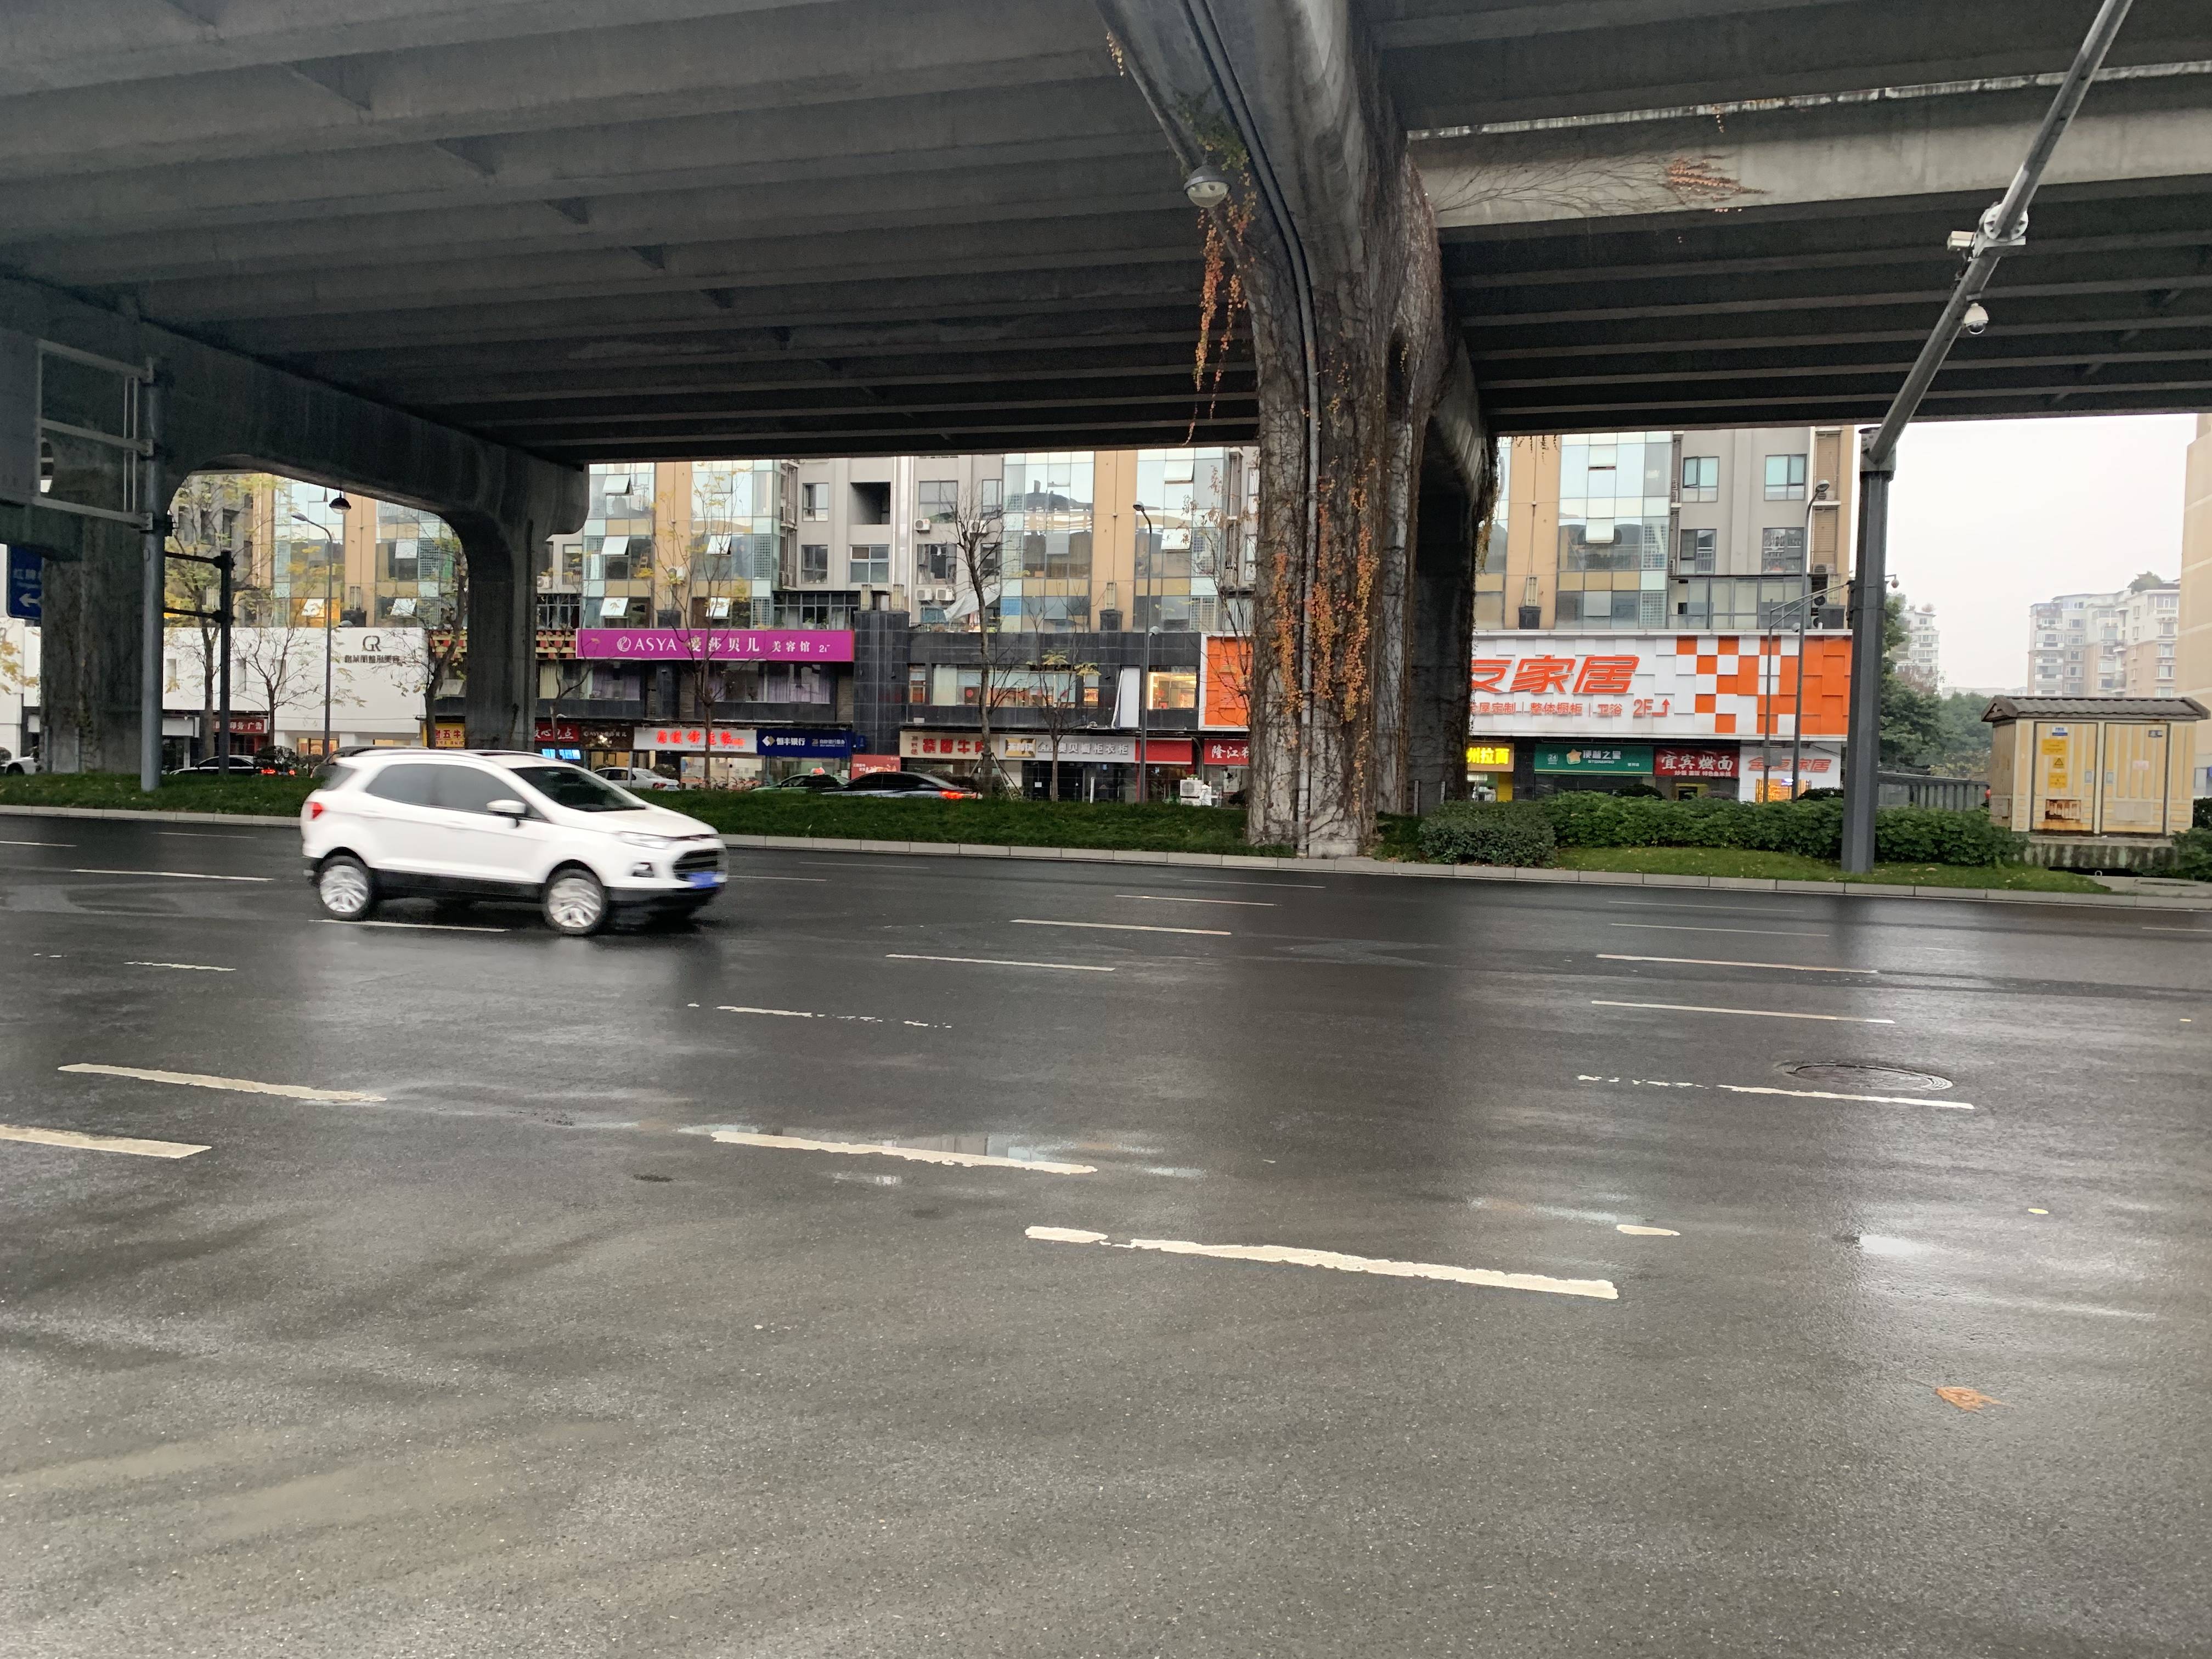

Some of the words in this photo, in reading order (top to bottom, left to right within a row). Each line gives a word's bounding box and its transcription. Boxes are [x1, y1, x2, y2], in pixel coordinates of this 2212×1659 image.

[634, 637, 677, 651] ASYA
[772, 640, 810, 653] 美容馆
[1530, 702, 1583, 715] 整体橱柜
[1598, 703, 1622, 716] 卫浴
[1633, 699, 1654, 716] 2F
[247, 721, 262, 730] 广告
[776, 737, 806, 746] 恒丰银行
[1661, 754, 1733, 771] 宜宾燃面
